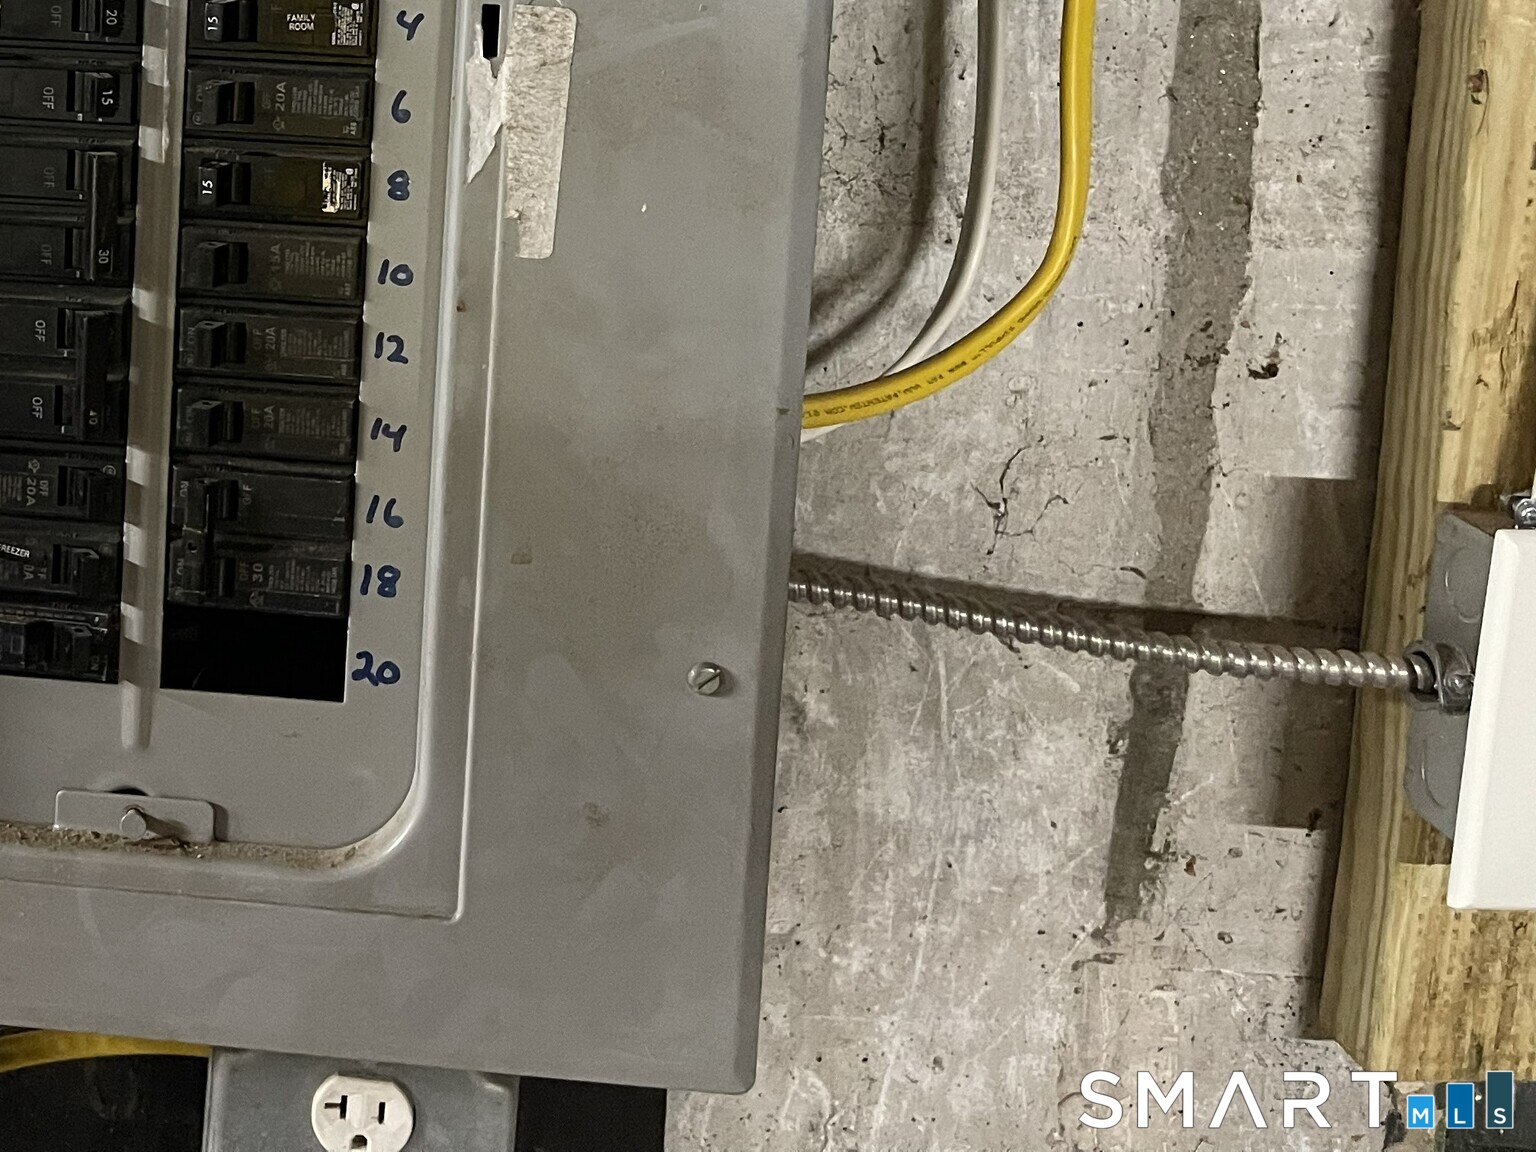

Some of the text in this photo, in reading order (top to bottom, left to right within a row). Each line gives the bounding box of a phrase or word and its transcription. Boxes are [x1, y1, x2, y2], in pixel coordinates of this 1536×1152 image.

[50, 5, 62, 29] OFF
[106, 9, 118, 25] 20
[208, 16, 219, 31] 15
[286, 13, 317, 22] FAMILY
[289, 22, 316, 31] ROOM
[397, 11, 424, 41] 4
[42, 86, 55, 110] OFF
[101, 89, 113, 106] 15
[275, 81, 286, 112] 20A
[391, 89, 411, 123] 6
[43, 166, 55, 188] OFF
[201, 179, 213, 196] 15
[387, 171, 409, 201] 8
[40, 244, 52, 266] OFF
[98, 249, 110, 264] 30
[270, 243, 281, 272] 15A
[378, 260, 413, 286] 10
[34, 319, 46, 342] OFF
[265, 326, 276, 350] 20A
[375, 334, 409, 363] 12
[31, 396, 43, 419] OFF
[265, 405, 276, 429] 20A
[371, 418, 407, 452] 14
[26, 477, 37, 506] 20A
[367, 495, 404, 528] 16
[252, 563, 264, 583] 30
[361, 565, 400, 597] 18
[352, 651, 400, 685] 20
